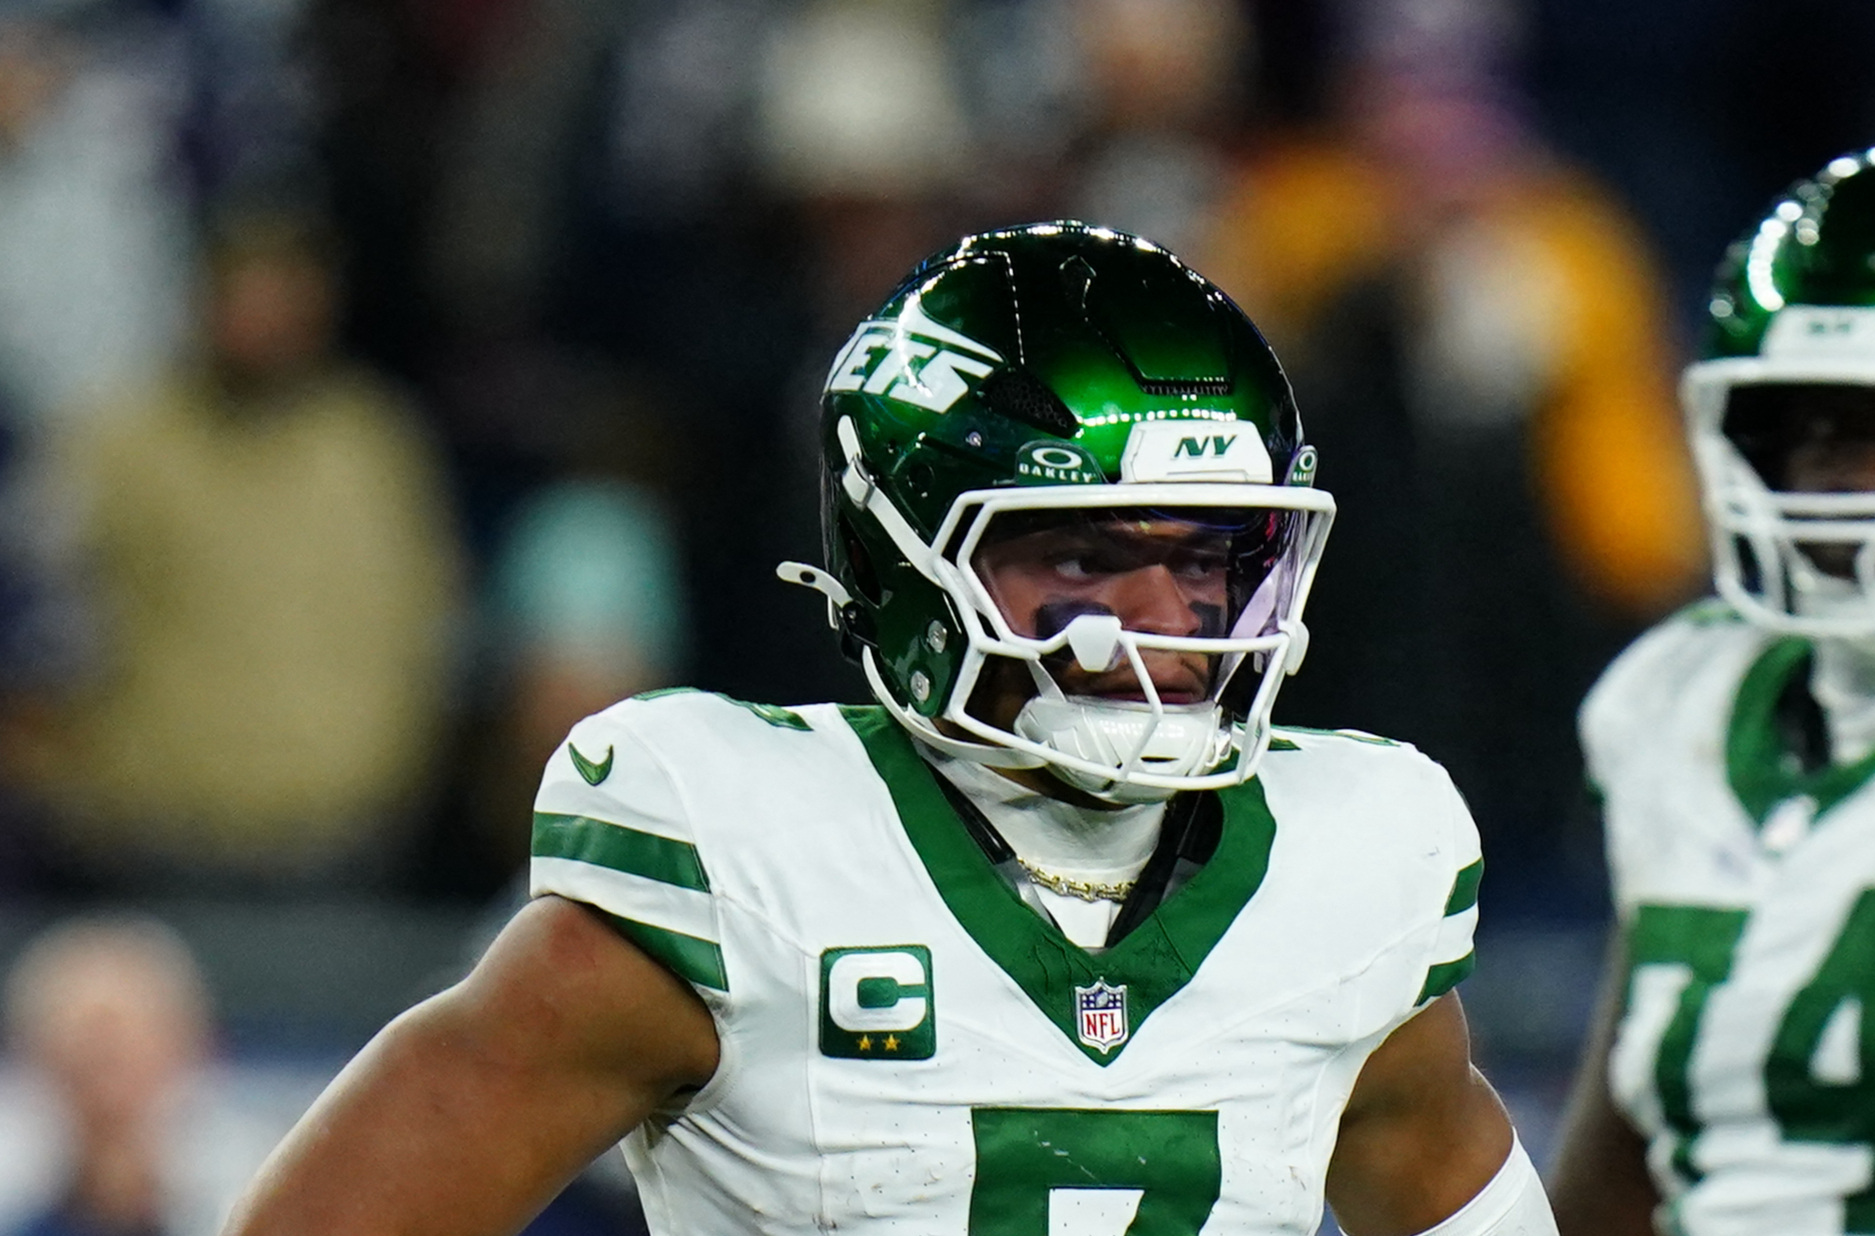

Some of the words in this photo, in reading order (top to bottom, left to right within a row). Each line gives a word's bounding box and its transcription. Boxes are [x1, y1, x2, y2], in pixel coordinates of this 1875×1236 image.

[1174, 434, 1237, 458] NY
[1019, 462, 1093, 483] OAKLEY
[828, 951, 926, 1031] C
[1085, 1012, 1120, 1039] NFL
